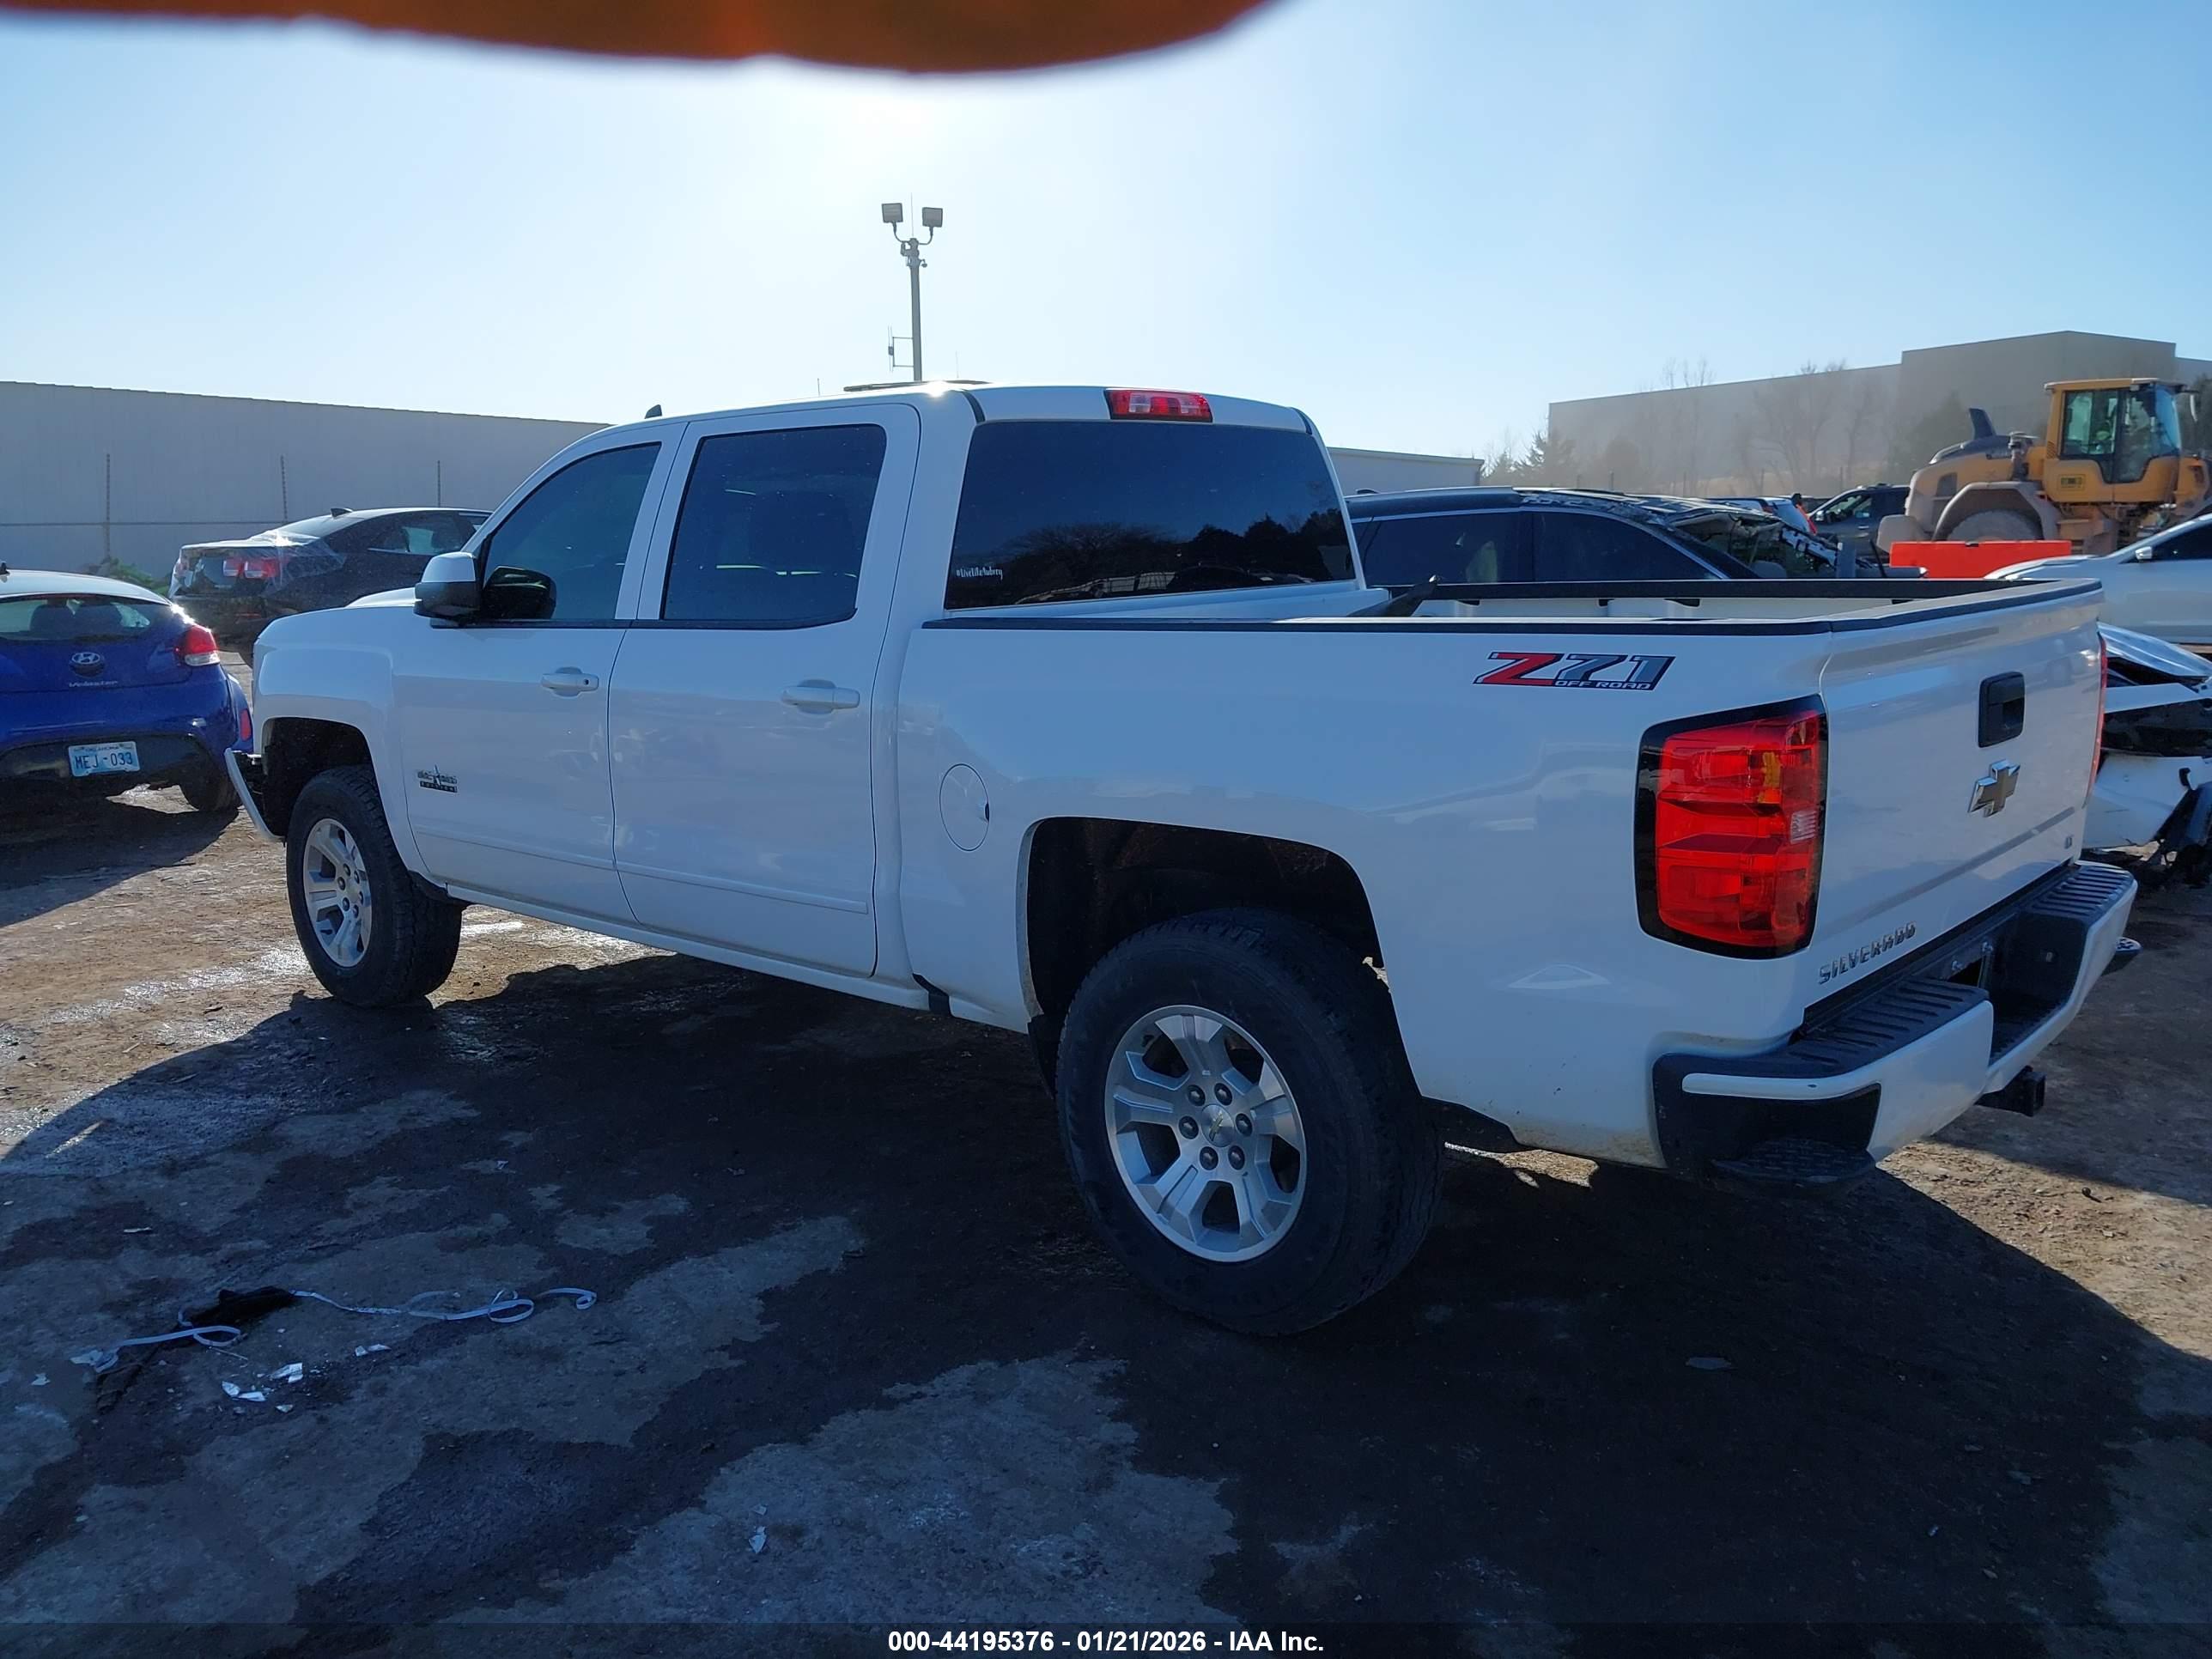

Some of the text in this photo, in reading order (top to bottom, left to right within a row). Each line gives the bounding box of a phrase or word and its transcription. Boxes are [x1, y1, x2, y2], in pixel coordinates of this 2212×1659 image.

[1473, 652, 1676, 690] Z71
[1595, 681, 1652, 690] ROAD
[1818, 921, 1916, 985] SILVERADO
